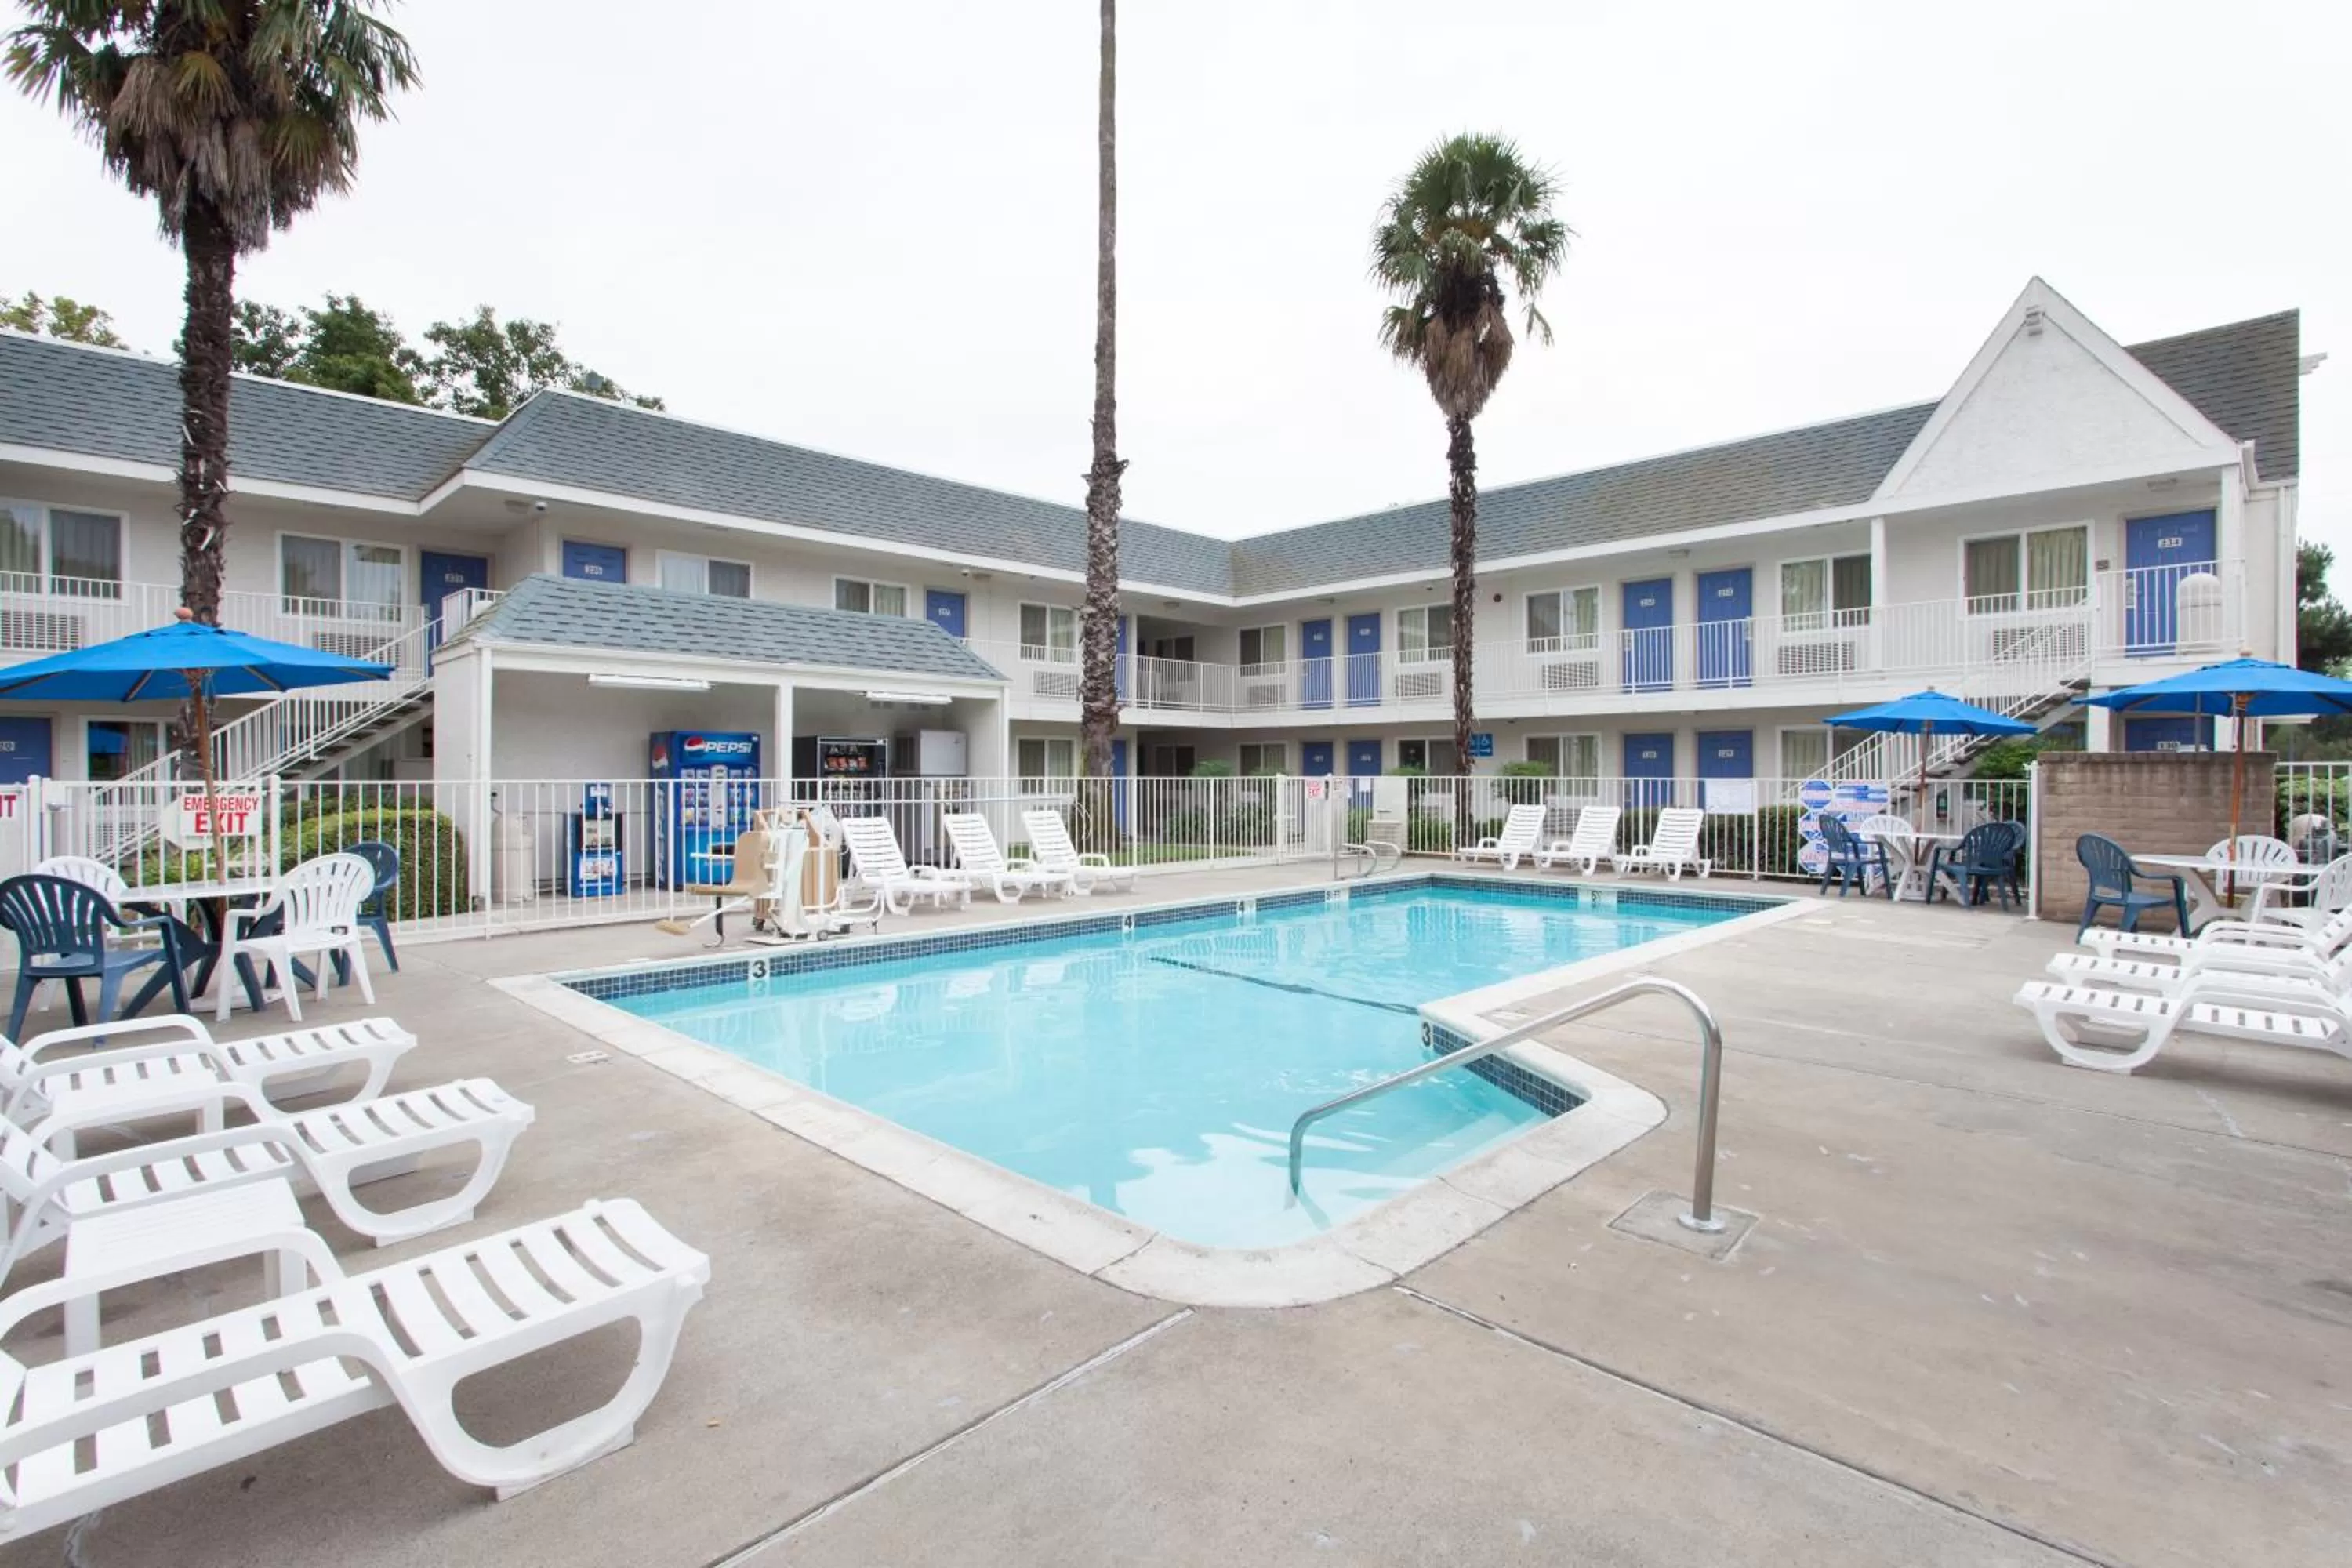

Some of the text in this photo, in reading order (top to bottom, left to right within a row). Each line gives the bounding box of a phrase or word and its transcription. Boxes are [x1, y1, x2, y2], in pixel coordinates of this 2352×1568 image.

[705, 741, 752, 753] PEPSI
[1124, 916, 1132, 928] 4
[753, 960, 766, 978] 3
[1421, 1022, 1430, 1047] 3
